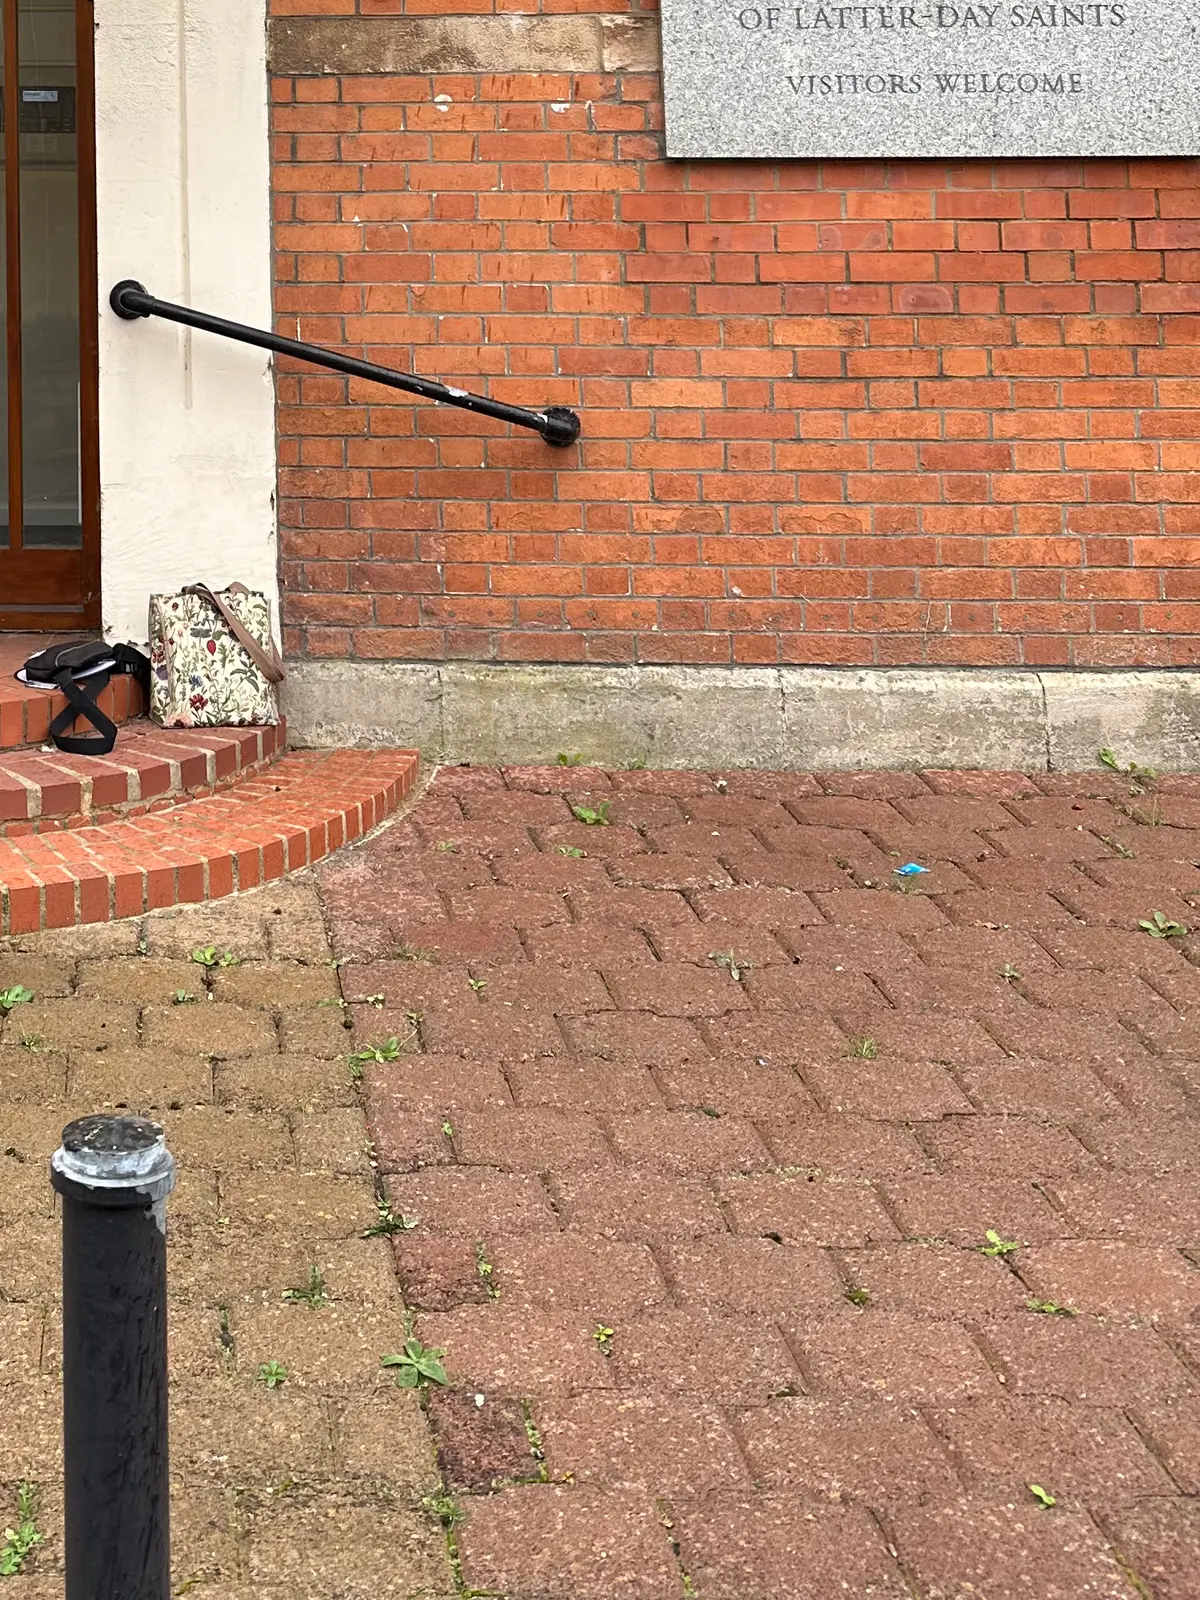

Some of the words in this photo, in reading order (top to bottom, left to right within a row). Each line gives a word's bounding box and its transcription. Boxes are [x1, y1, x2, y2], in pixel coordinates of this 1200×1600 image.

[739, 7, 781, 31] OF
[794, 4, 1002, 30] LATTER-DAY
[1011, 3, 1127, 28] SAINTS
[785, 74, 922, 96] VISITORS
[935, 72, 1085, 95] WELCOME
